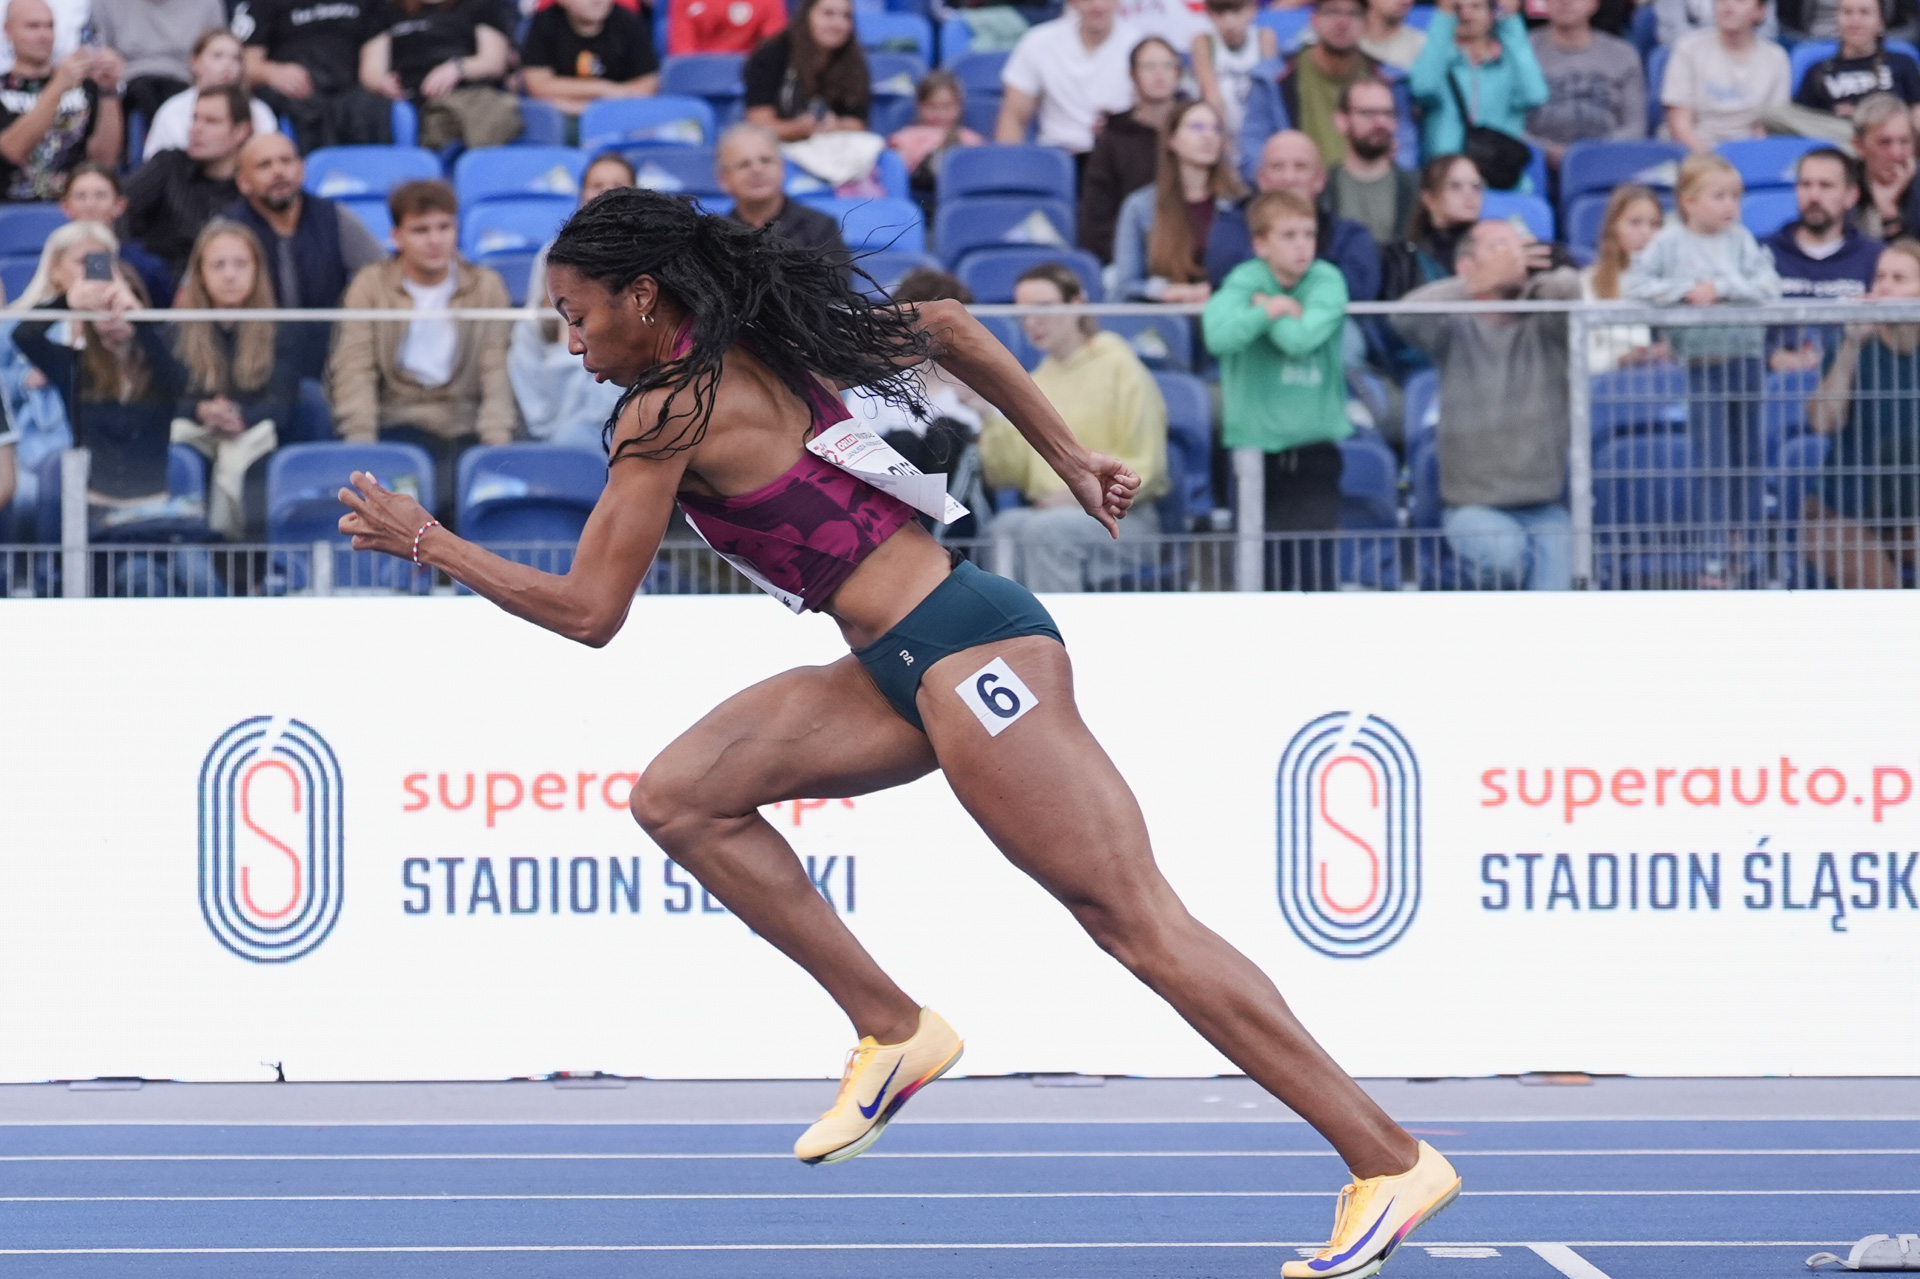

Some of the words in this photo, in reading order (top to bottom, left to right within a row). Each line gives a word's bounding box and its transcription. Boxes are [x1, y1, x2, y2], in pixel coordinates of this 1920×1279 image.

[977, 673, 1020, 718] 6
[1481, 756, 1920, 823] superauto.p
[404, 856, 640, 914] STADION
[1481, 852, 1720, 909] STADION
